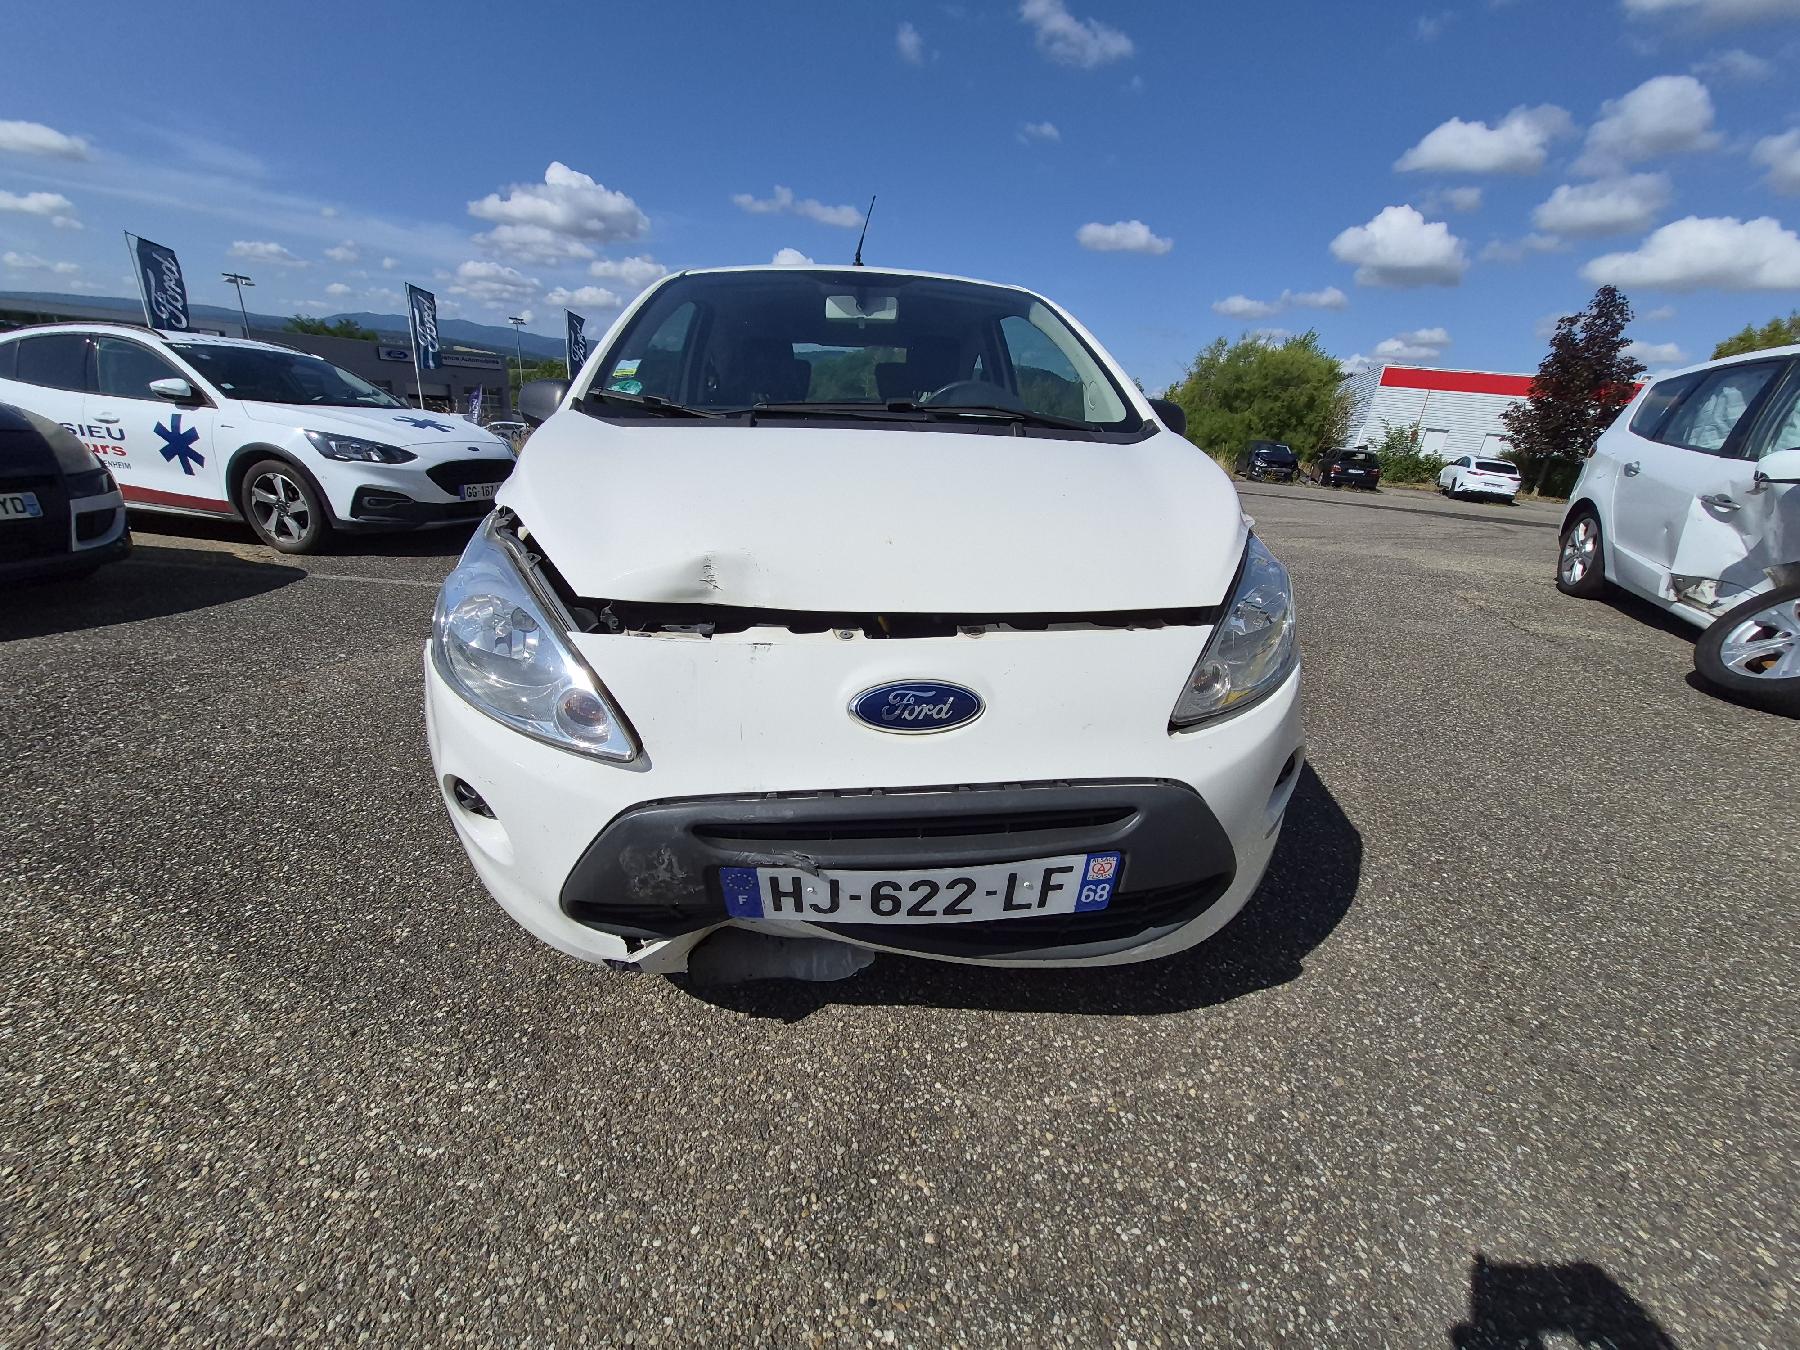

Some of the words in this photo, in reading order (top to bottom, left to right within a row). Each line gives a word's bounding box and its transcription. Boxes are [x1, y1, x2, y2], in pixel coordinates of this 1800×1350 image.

[146, 251, 188, 328] Ford
[413, 294, 439, 352] Ford
[882, 690, 954, 721] Ford
[738, 895, 748, 905] F
[769, 865, 1074, 917] HJ-622-LF
[1080, 883, 1110, 903] 68
